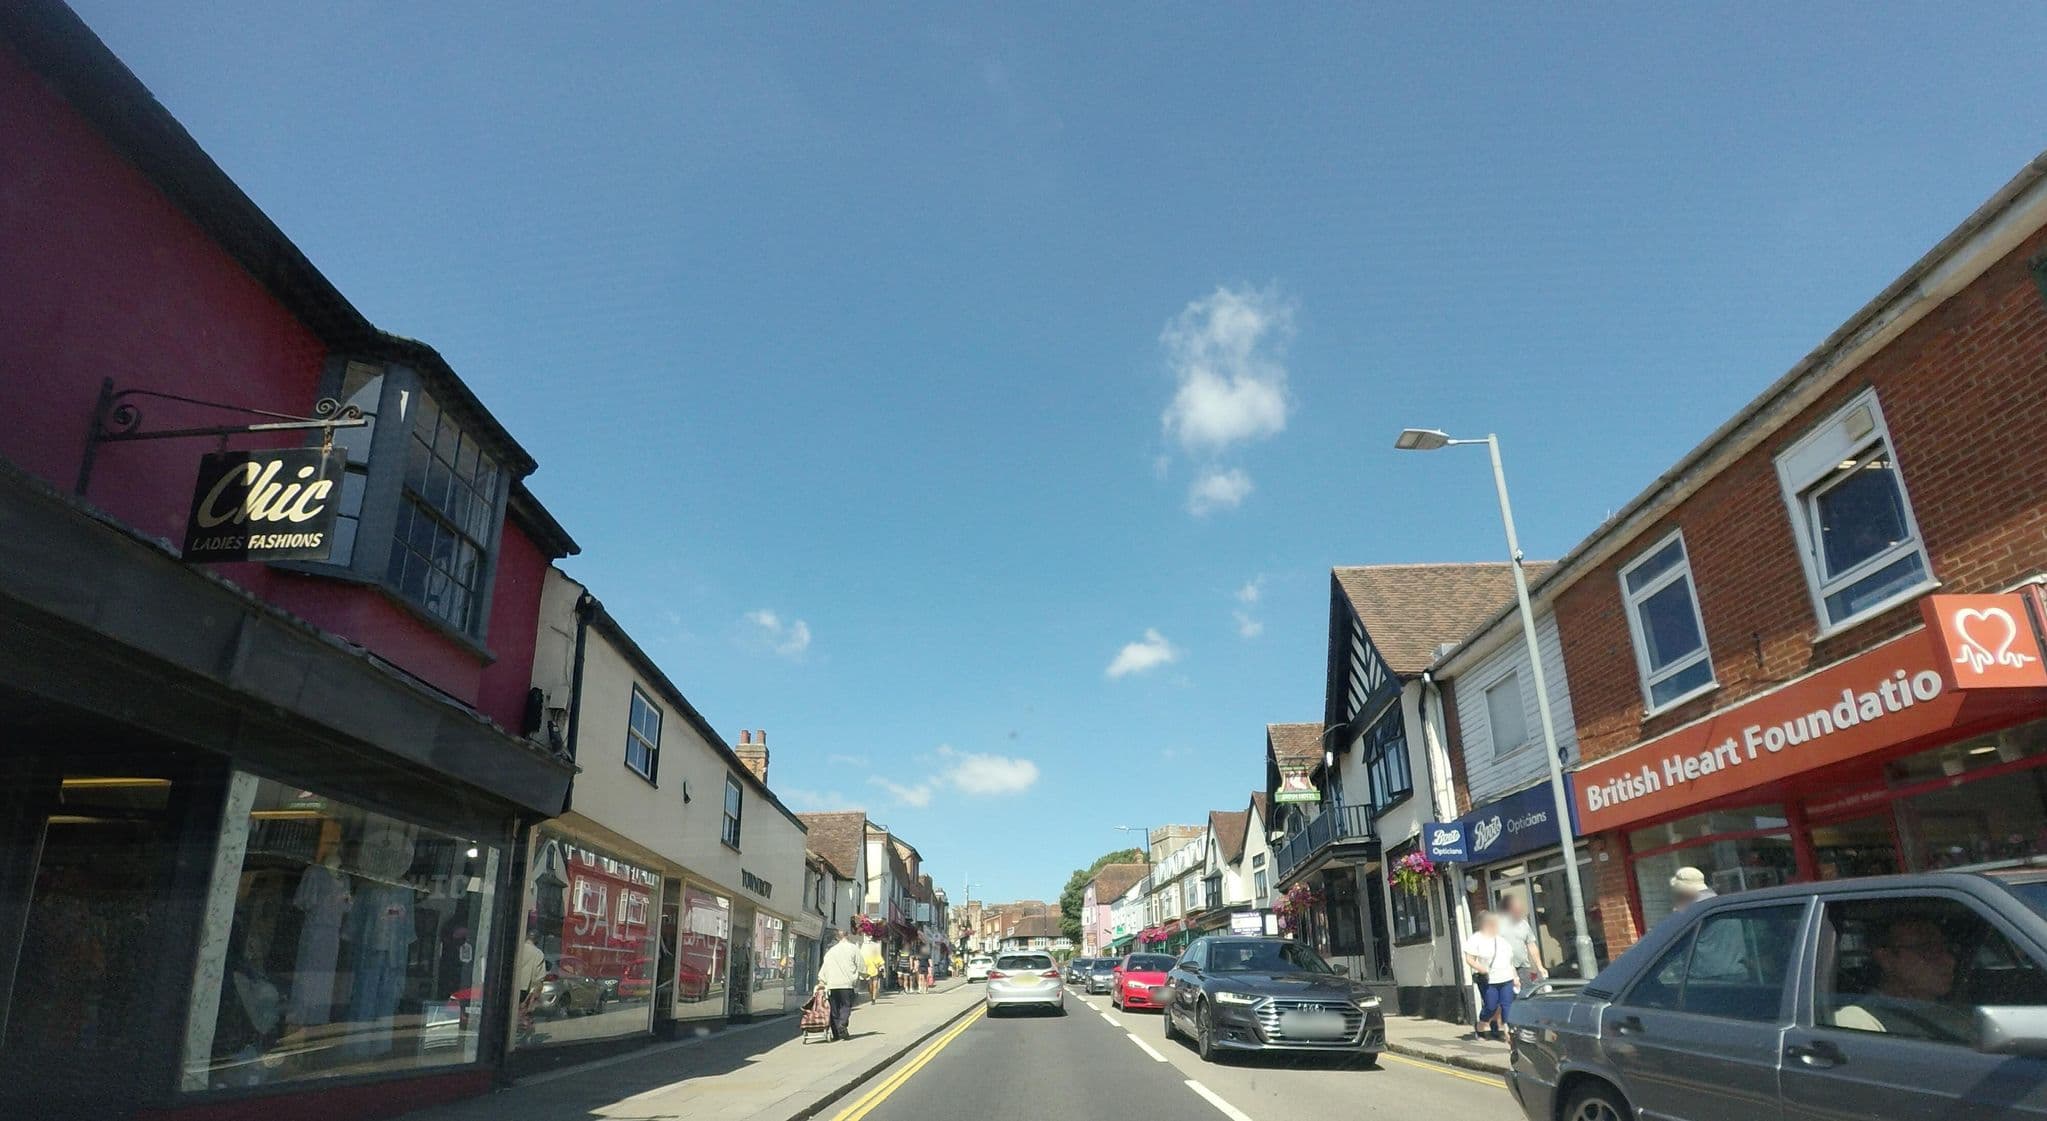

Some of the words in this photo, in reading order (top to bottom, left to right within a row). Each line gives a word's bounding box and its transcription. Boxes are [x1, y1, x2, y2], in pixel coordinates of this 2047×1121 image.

[197, 460, 333, 528] Chic
[192, 536, 244, 551] LADIES
[247, 532, 324, 549] FASHIONS
[1585, 765, 1661, 812] British
[1662, 737, 1742, 787] Heart
[1743, 669, 1943, 760] Foundatio
[1432, 829, 1461, 846] Boots
[1473, 815, 1502, 852] Boots
[1507, 811, 1547, 834] Opticians
